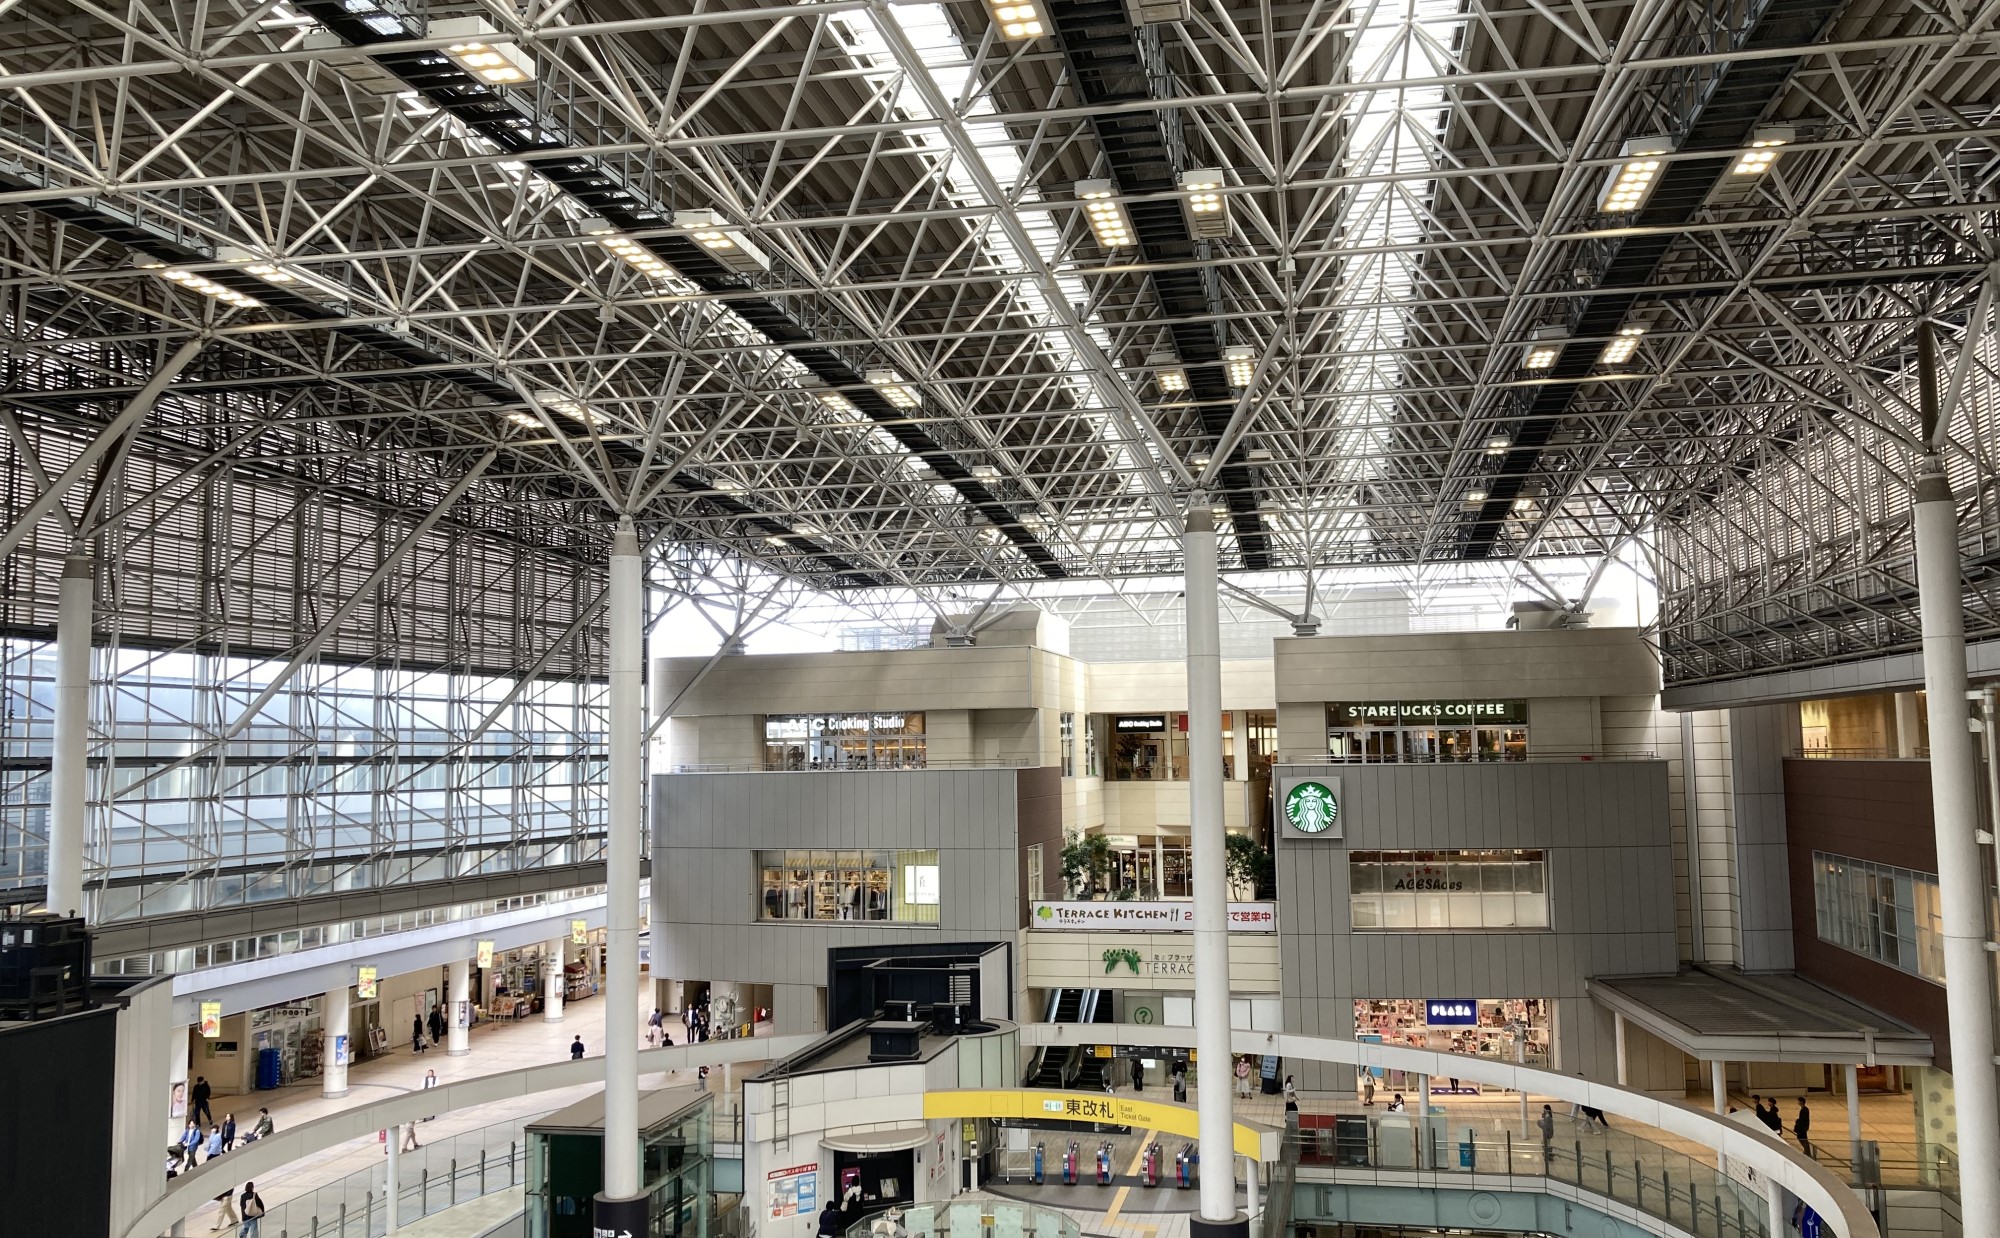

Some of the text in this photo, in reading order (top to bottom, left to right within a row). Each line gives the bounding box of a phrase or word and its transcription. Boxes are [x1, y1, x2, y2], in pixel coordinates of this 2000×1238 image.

[1348, 703, 1505, 717] STARBUCKS COFFEE
[787, 716, 905, 731] ABC Cooking Studio
[1056, 907, 1168, 919] TERRACE KITCHEN
[1227, 911, 1271, 922] で営業中
[1431, 1004, 1472, 1016] PLAZA
[1066, 1098, 1114, 1118] 東改札
[1120, 1112, 1151, 1122] Ticket Gate
